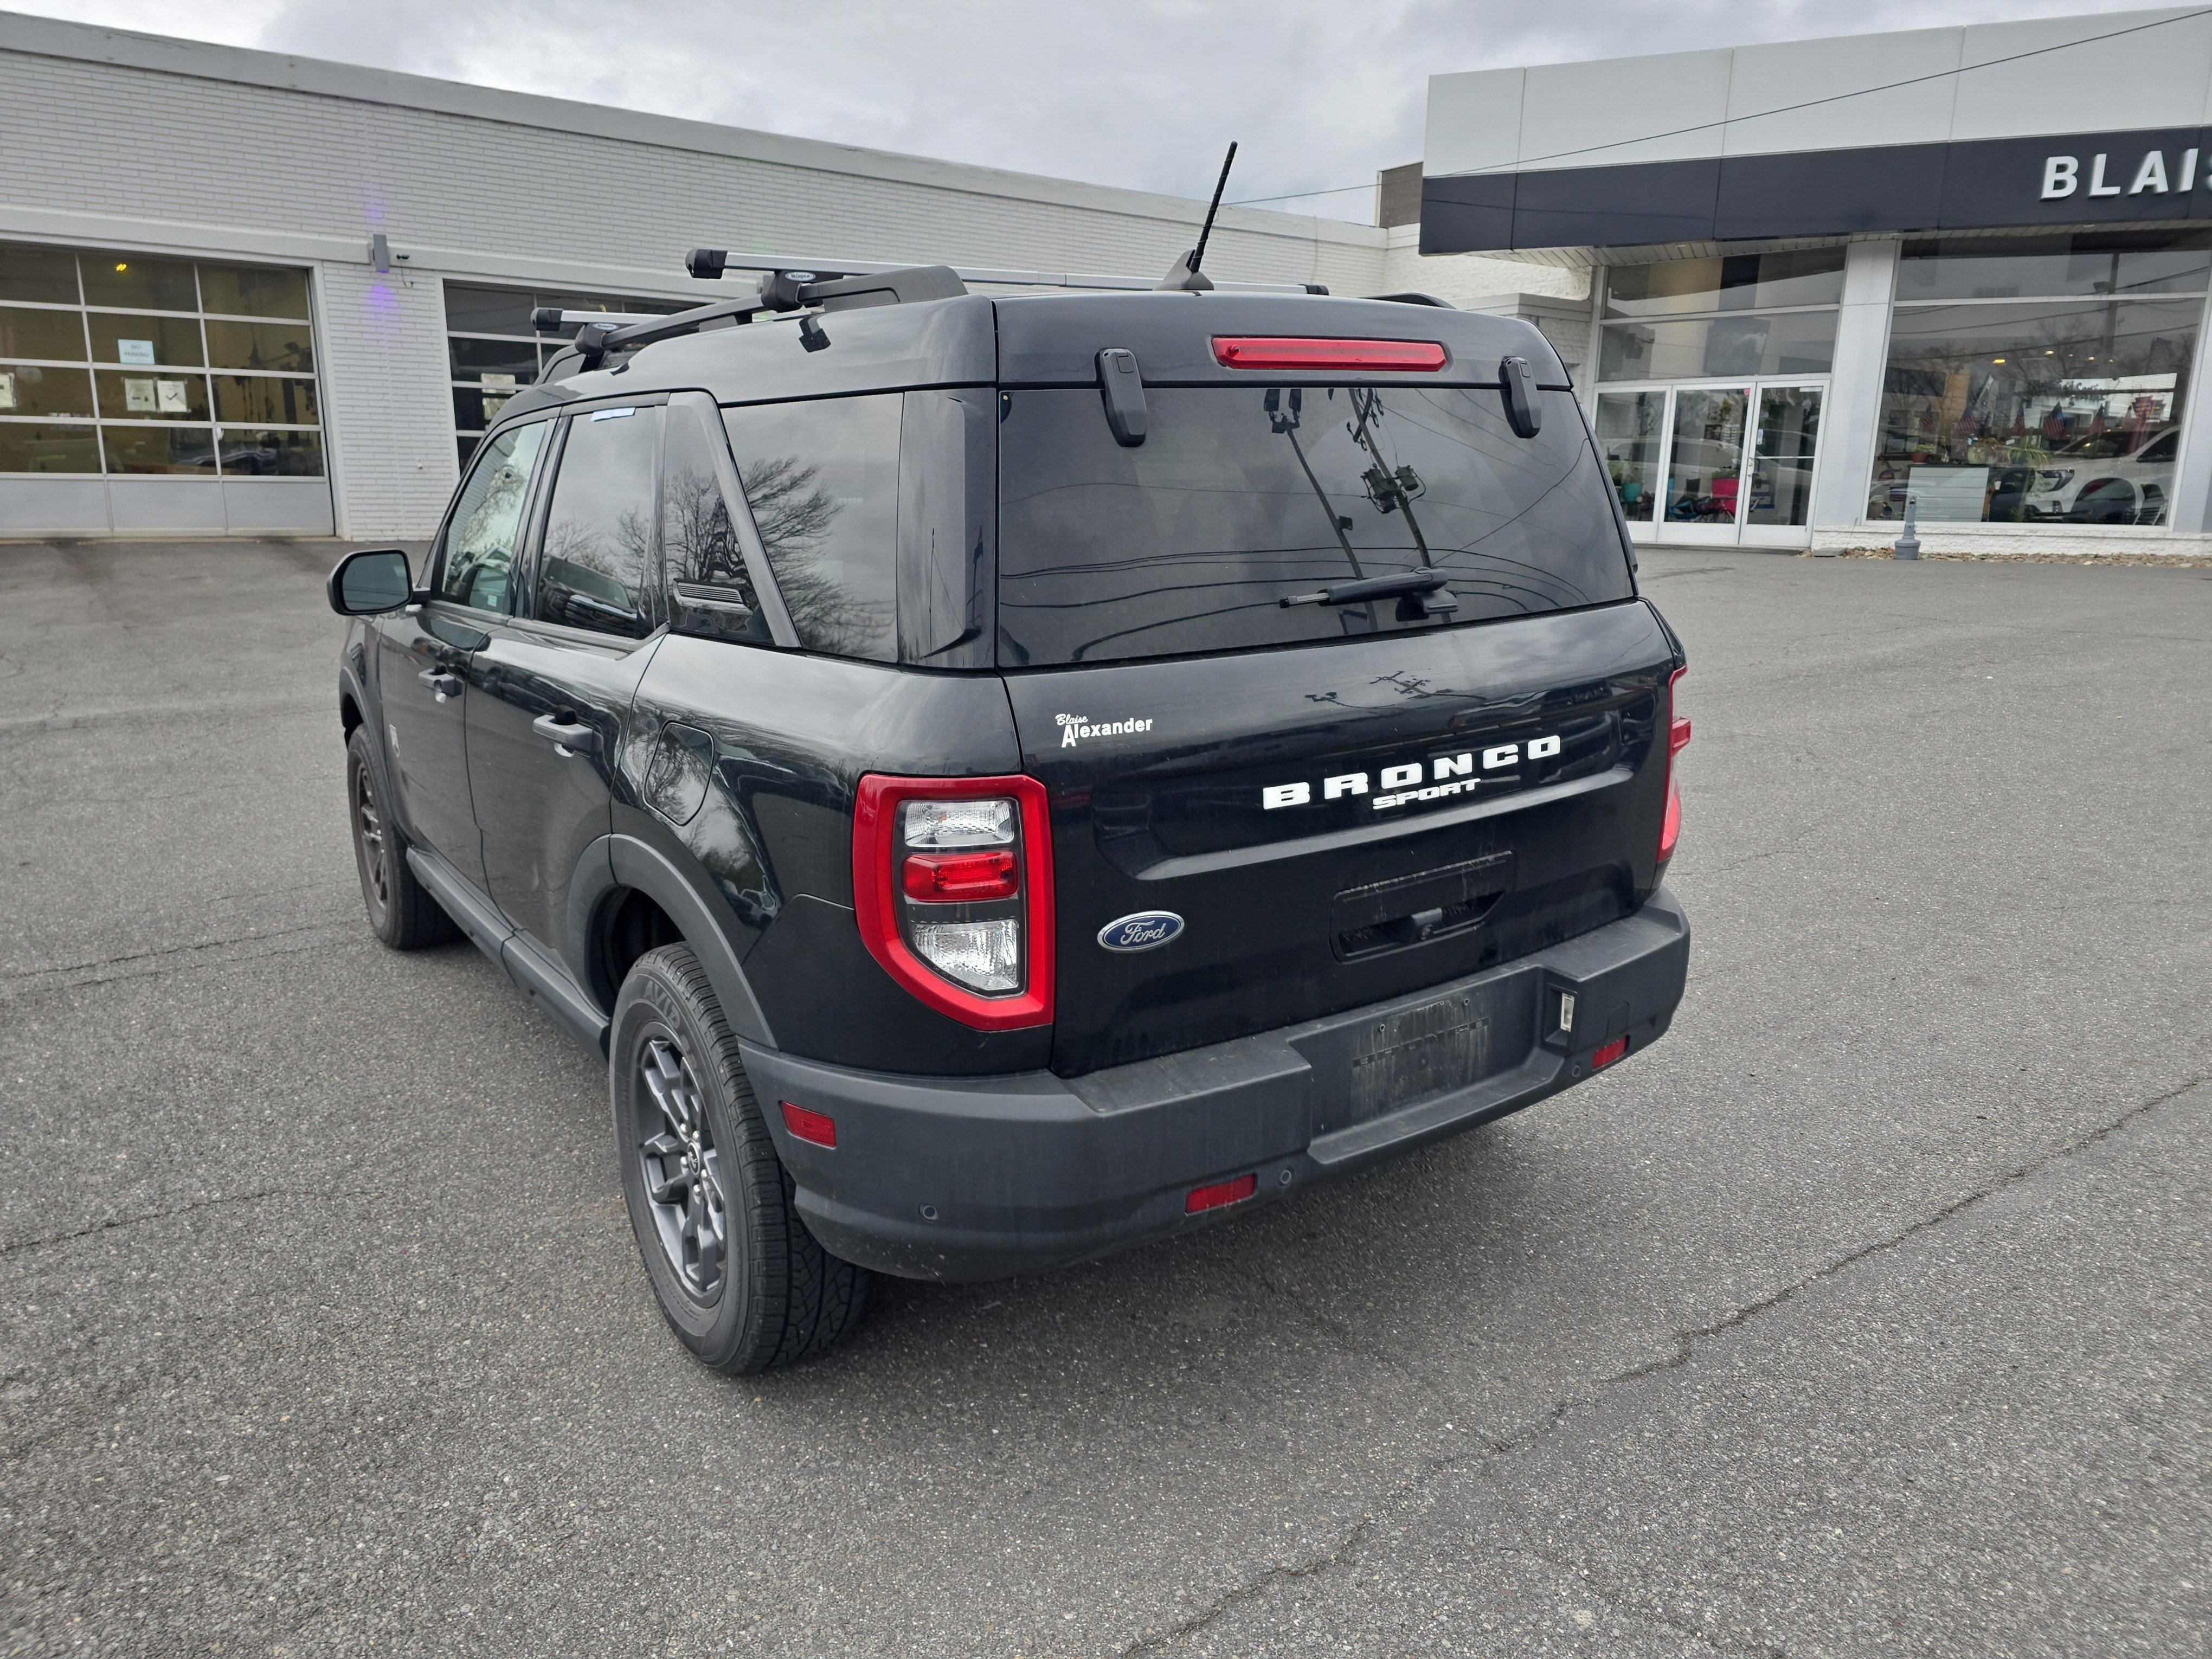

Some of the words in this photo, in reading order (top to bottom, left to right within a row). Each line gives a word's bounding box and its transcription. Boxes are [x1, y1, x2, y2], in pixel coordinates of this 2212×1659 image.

[2040, 147, 2212, 201] BLAI
[1055, 713, 1089, 726] Blaise
[1061, 717, 1153, 748] Alexander
[1263, 735, 1561, 810] BRONCO
[1373, 778, 1481, 810] SPORT
[1120, 920, 1167, 945] Ford
[644, 979, 681, 1030] AVID
